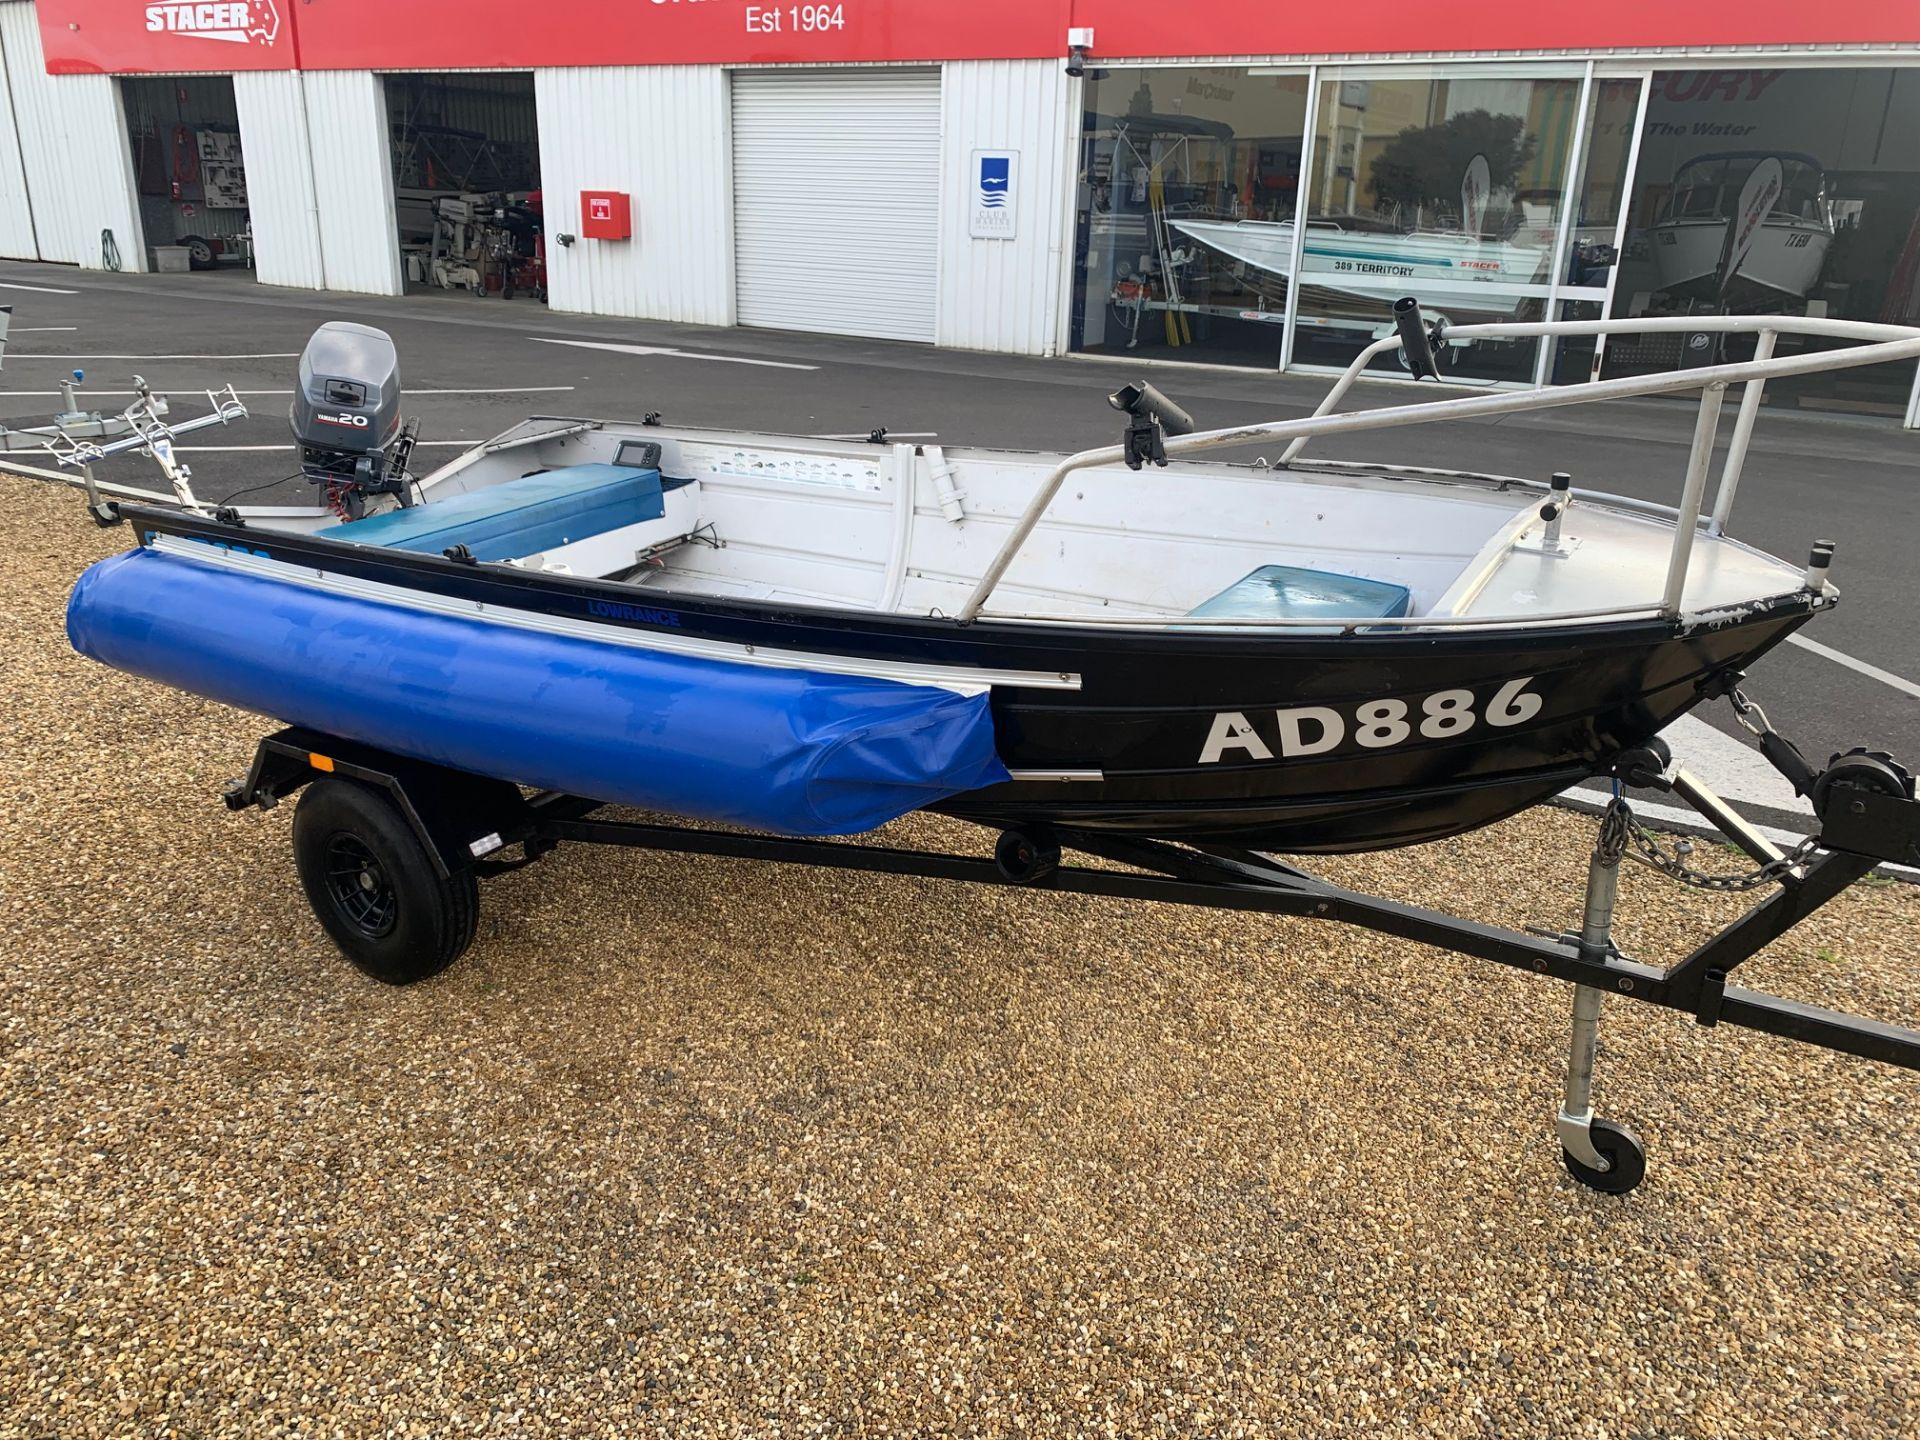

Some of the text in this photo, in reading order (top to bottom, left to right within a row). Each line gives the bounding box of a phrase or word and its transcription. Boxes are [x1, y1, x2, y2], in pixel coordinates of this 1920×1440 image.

[145, 3, 249, 31] STACER
[745, 4, 845, 33] Est 1964
[1650, 122, 1687, 137] The
[1692, 122, 1758, 137] Water
[1334, 261, 1415, 277] 389 TERRITORY
[1460, 261, 1500, 269] STACER
[317, 412, 368, 427] YAMAHA 20
[588, 600, 681, 627] LOWRANCE
[1197, 676, 1543, 764] AD886
